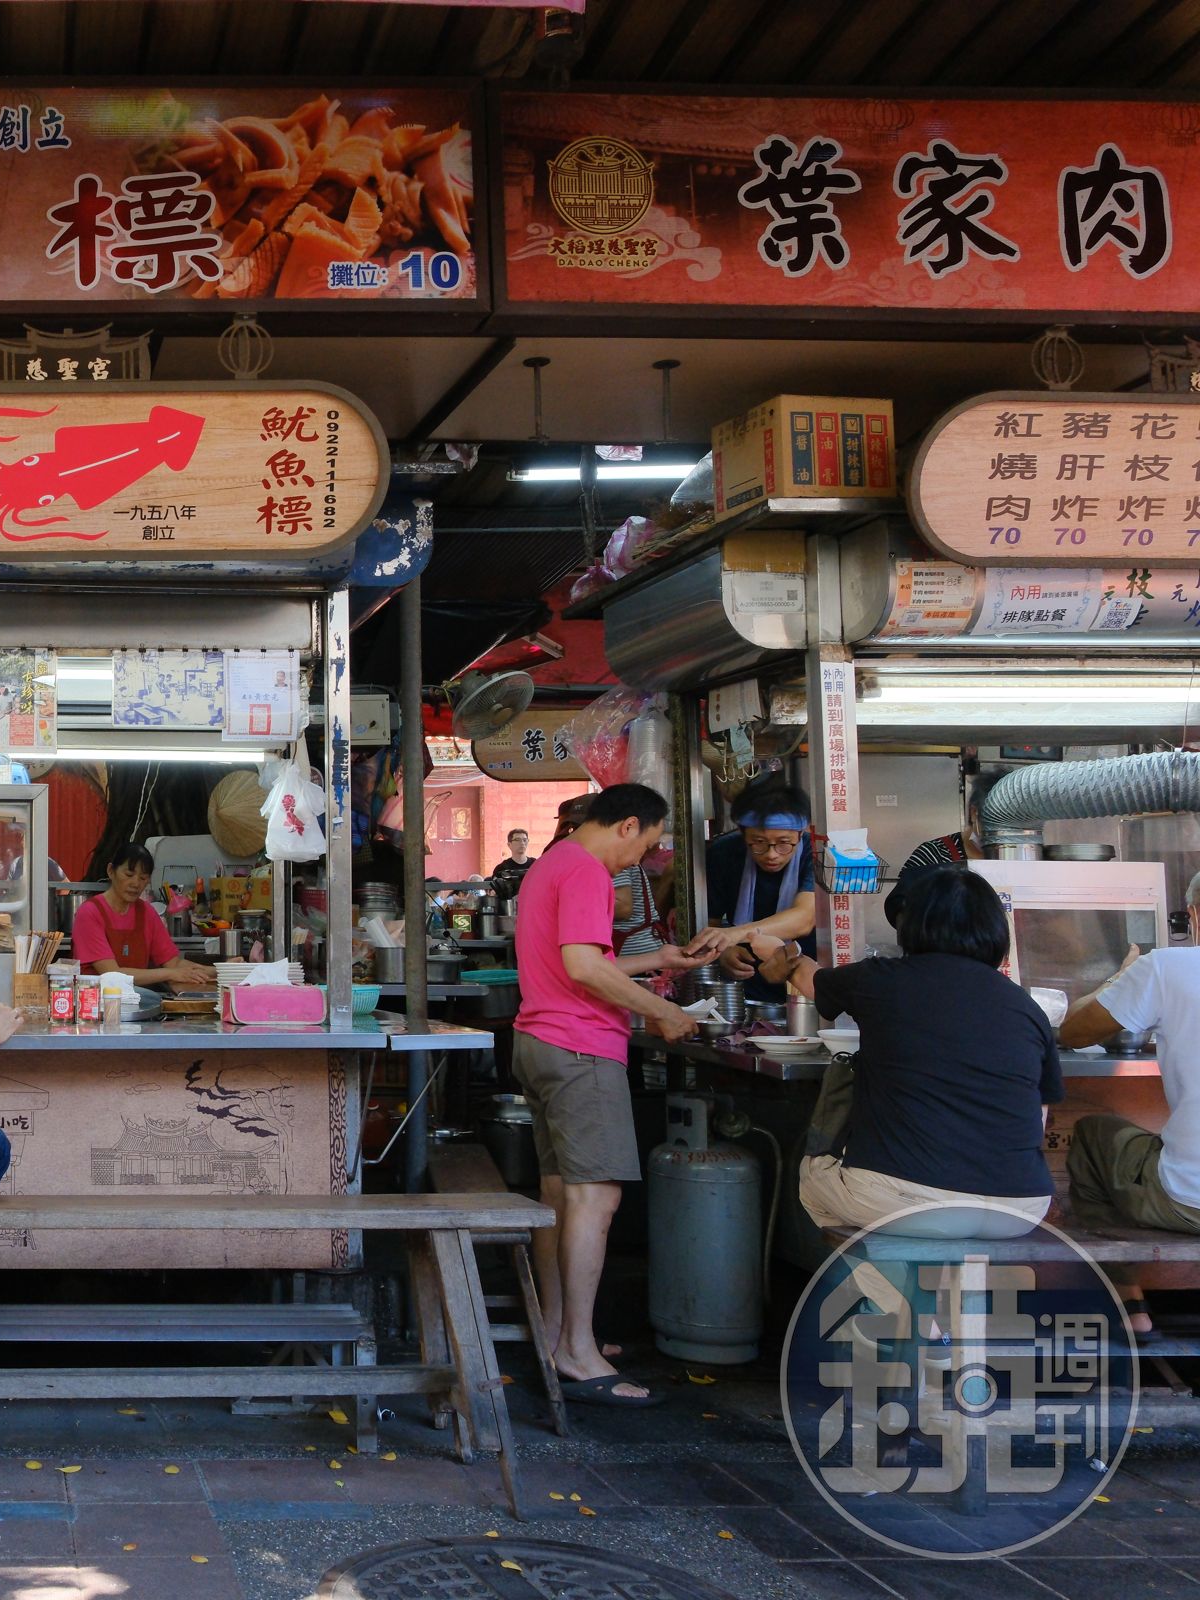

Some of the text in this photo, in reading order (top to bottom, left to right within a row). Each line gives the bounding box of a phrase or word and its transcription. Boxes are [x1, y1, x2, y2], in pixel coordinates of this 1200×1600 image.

[738, 134, 1172, 280] 葉家肉
[550, 237, 658, 257] 大稻埕慈聖宮
[558, 259, 649, 268] DA DAO CHENG
[25, 357, 112, 381] 慈聖宮
[256, 406, 320, 536] 魷魚標
[323, 410, 340, 528] 0922111682
[985, 411, 1043, 545] 紅燒肉 70
[1050, 412, 1112, 546] 豬肝炸 70
[1116, 413, 1179, 522] 花枝炸
[113, 505, 197, 521] 一九五八年
[142, 525, 176, 541] 創立
[1121, 529, 1154, 546] 70
[1000, 608, 1067, 624] 排隊點餐
